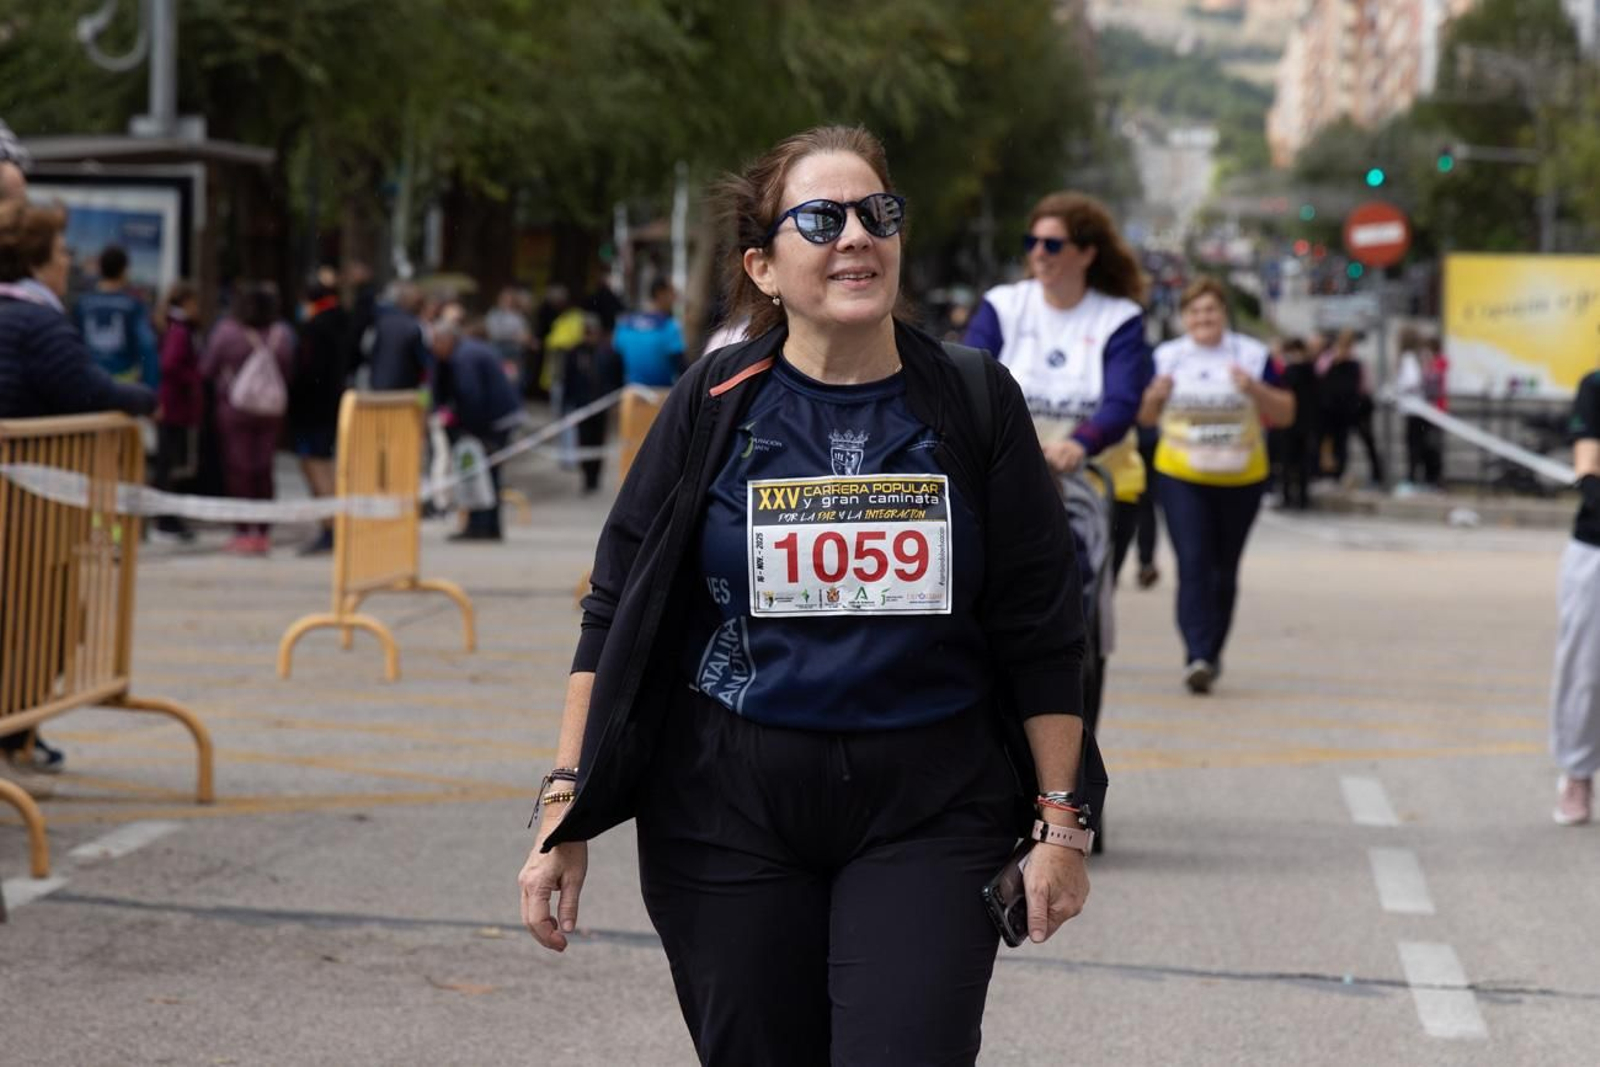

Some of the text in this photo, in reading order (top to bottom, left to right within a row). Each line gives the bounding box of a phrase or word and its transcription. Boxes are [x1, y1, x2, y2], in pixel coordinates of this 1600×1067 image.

[758, 483, 939, 510] XXV CARRERA POPULAR
[803, 492, 940, 509] y gran caminata
[778, 512, 798, 522] POR
[800, 511, 815, 522] LA
[817, 510, 836, 521] PAZ
[847, 510, 862, 520] LA
[774, 530, 929, 583] 1059
[706, 576, 731, 605] ES
